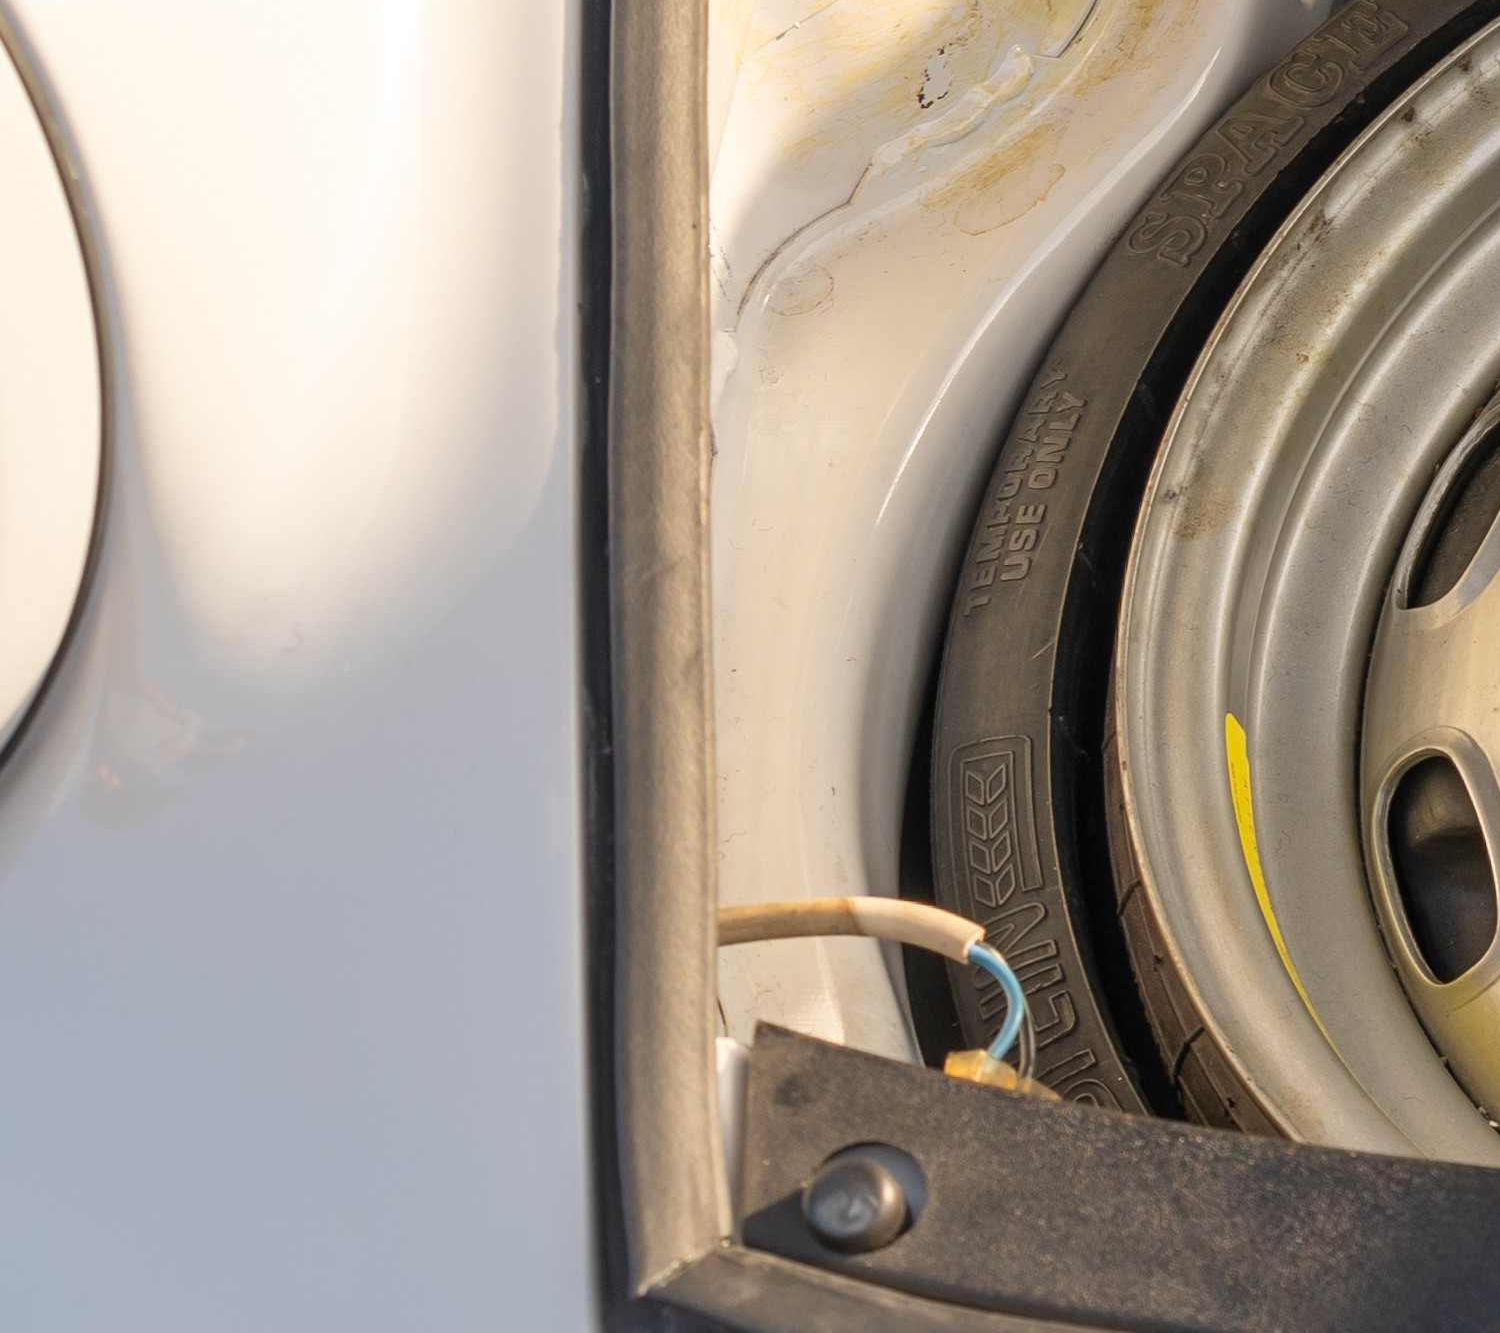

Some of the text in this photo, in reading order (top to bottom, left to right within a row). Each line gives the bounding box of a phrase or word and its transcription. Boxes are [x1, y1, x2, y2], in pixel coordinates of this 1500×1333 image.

[963, 354, 1069, 618] TEMPORARY
[1000, 391, 1087, 583] USE ONLY
